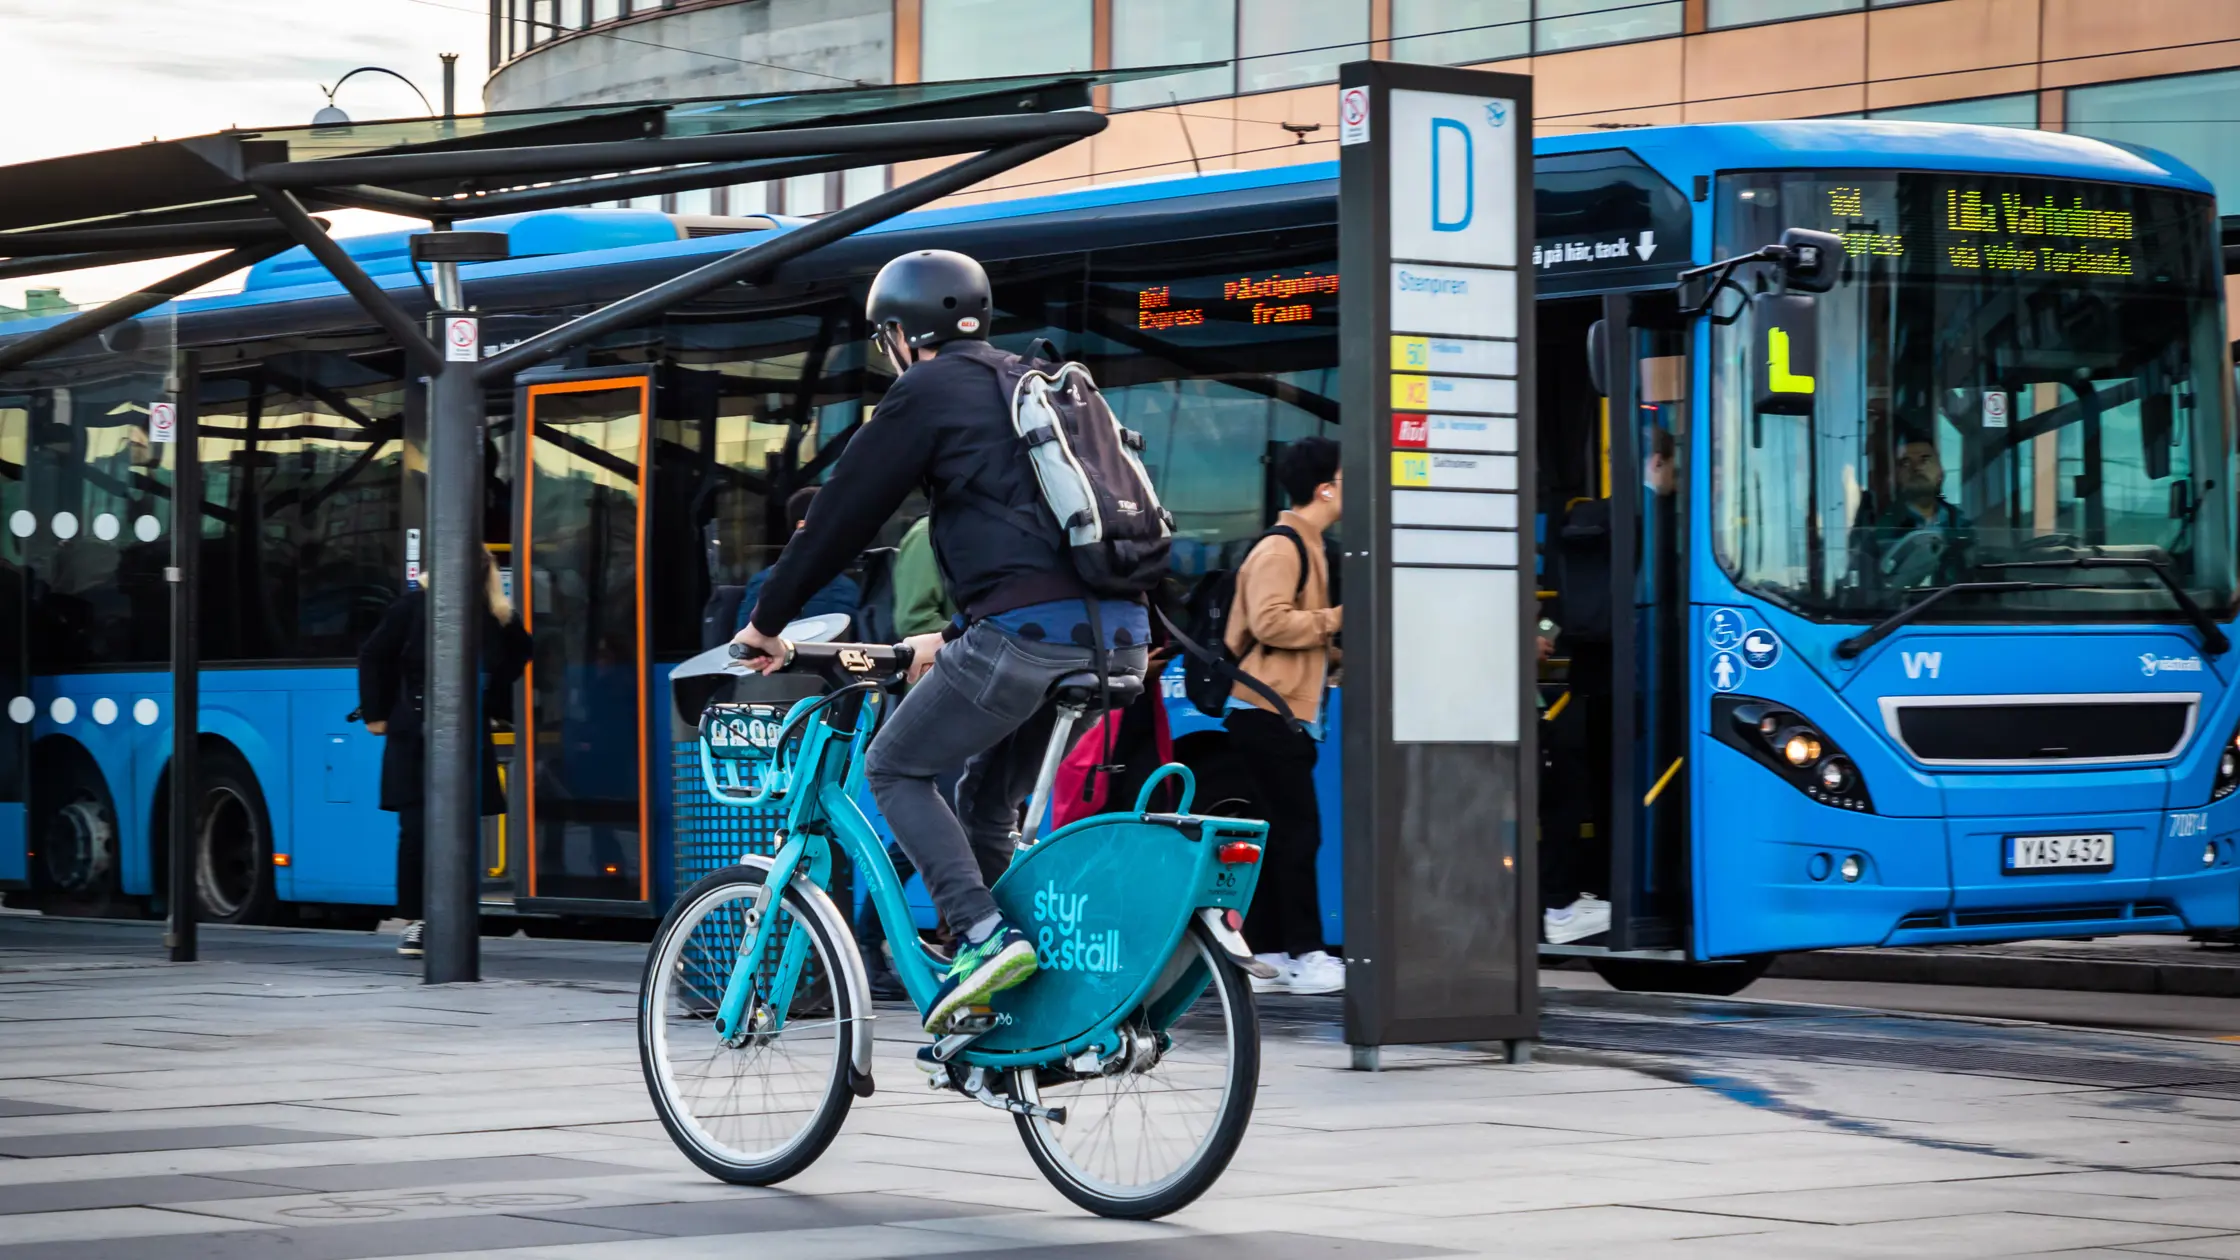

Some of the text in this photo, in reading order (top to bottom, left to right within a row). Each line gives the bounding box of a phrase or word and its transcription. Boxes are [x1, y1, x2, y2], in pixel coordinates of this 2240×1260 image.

[1431, 117, 1474, 232] D
[1532, 245, 1543, 265] å
[1543, 243, 1563, 269] på
[1595, 237, 1630, 259] tack
[1830, 228, 1904, 258] xpress
[1948, 239, 1981, 268] via
[1983, 241, 2037, 270] Volvo
[1139, 285, 1170, 309] Röd
[1139, 309, 1204, 330] Express
[1252, 302, 1312, 325] fram
[1398, 420, 1428, 442] Röd
[2021, 837, 2106, 866] YAS 432
[1033, 880, 1089, 936] styr
[1036, 925, 1120, 973] &ställ
